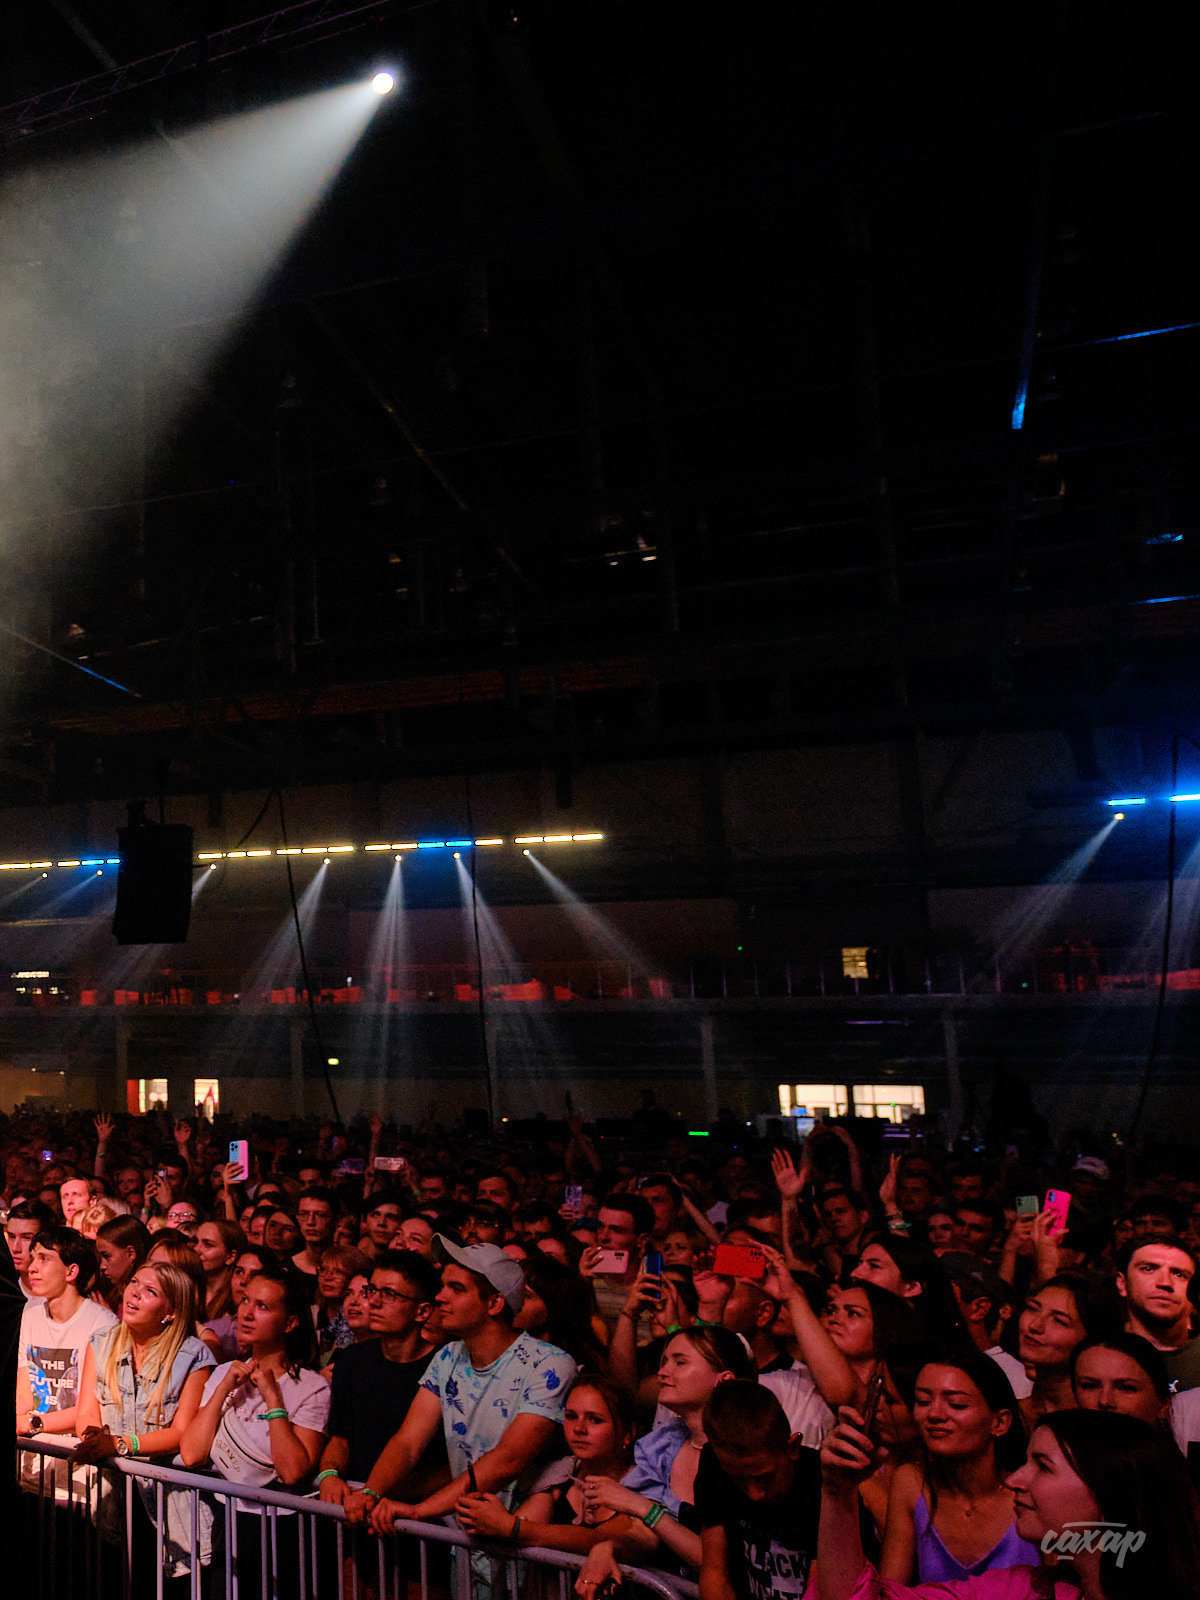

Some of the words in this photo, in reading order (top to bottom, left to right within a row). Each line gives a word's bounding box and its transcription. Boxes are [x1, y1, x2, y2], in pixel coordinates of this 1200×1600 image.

[40, 1360, 65, 1371] THE
[29, 1374, 74, 1389] FUTURE
[45, 1395, 58, 1406] IS
